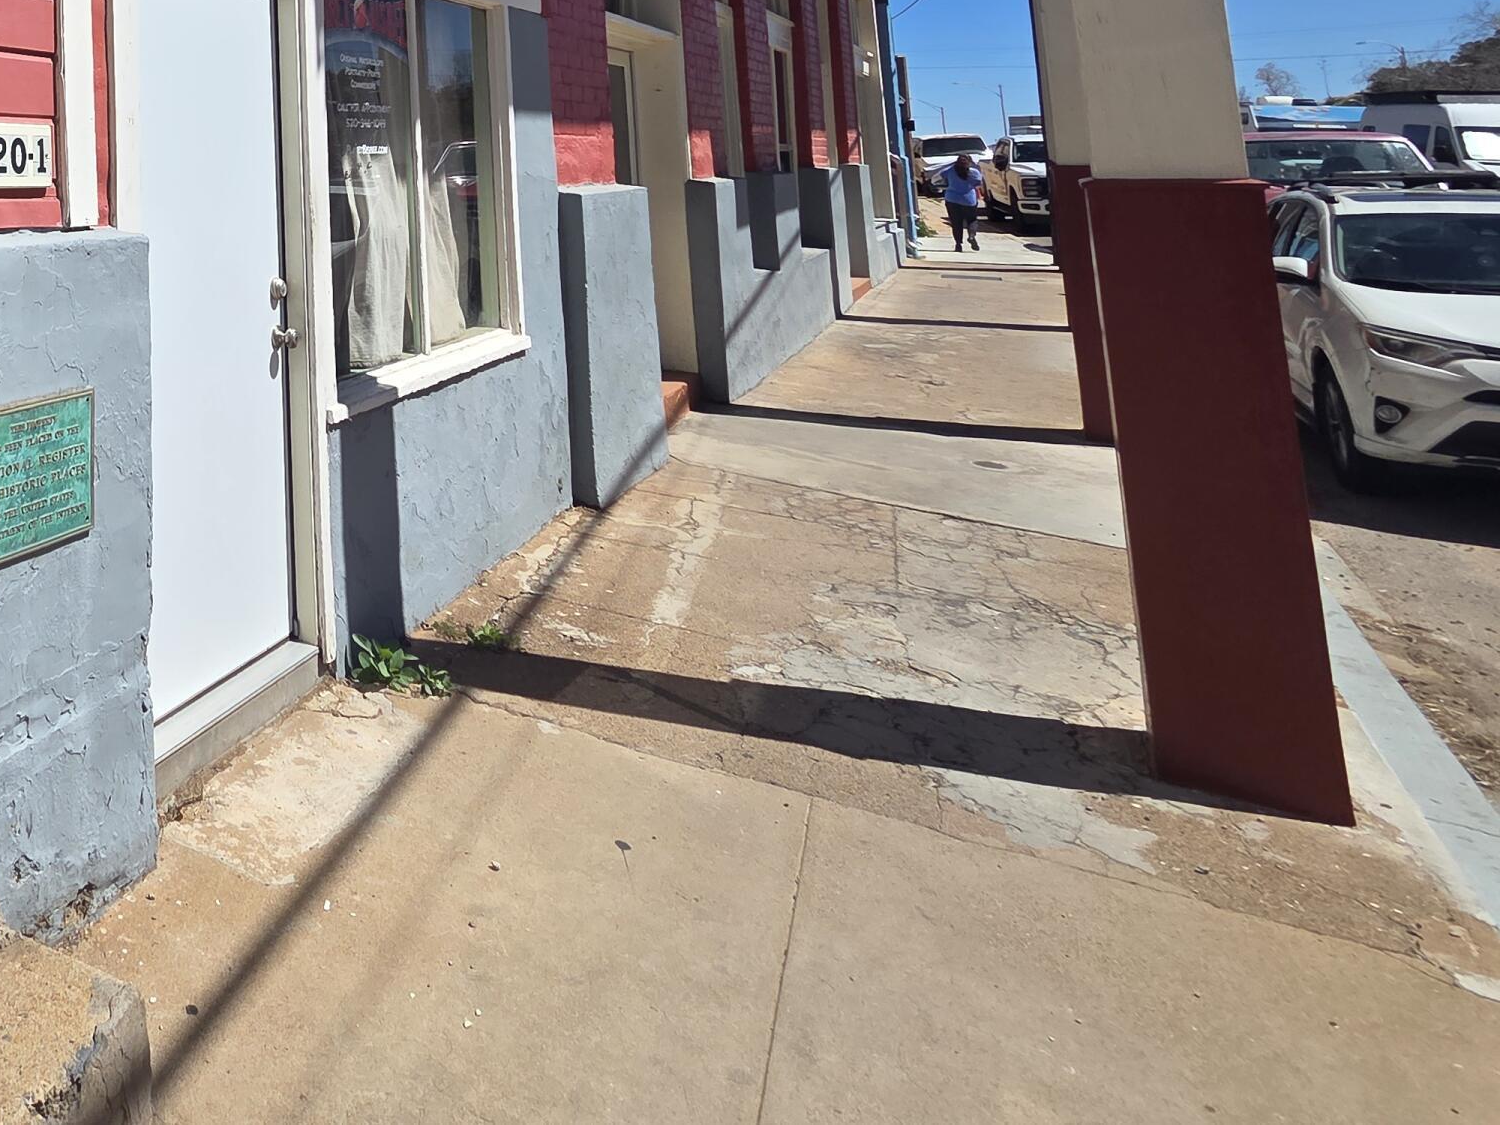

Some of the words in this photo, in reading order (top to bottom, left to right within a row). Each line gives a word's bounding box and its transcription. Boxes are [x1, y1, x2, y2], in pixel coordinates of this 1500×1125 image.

[25, 432, 52, 447] PLACED
[38, 443, 86, 465] REGISTER
[50, 463, 86, 484] PLACES
[20, 499, 48, 514] UNITED
